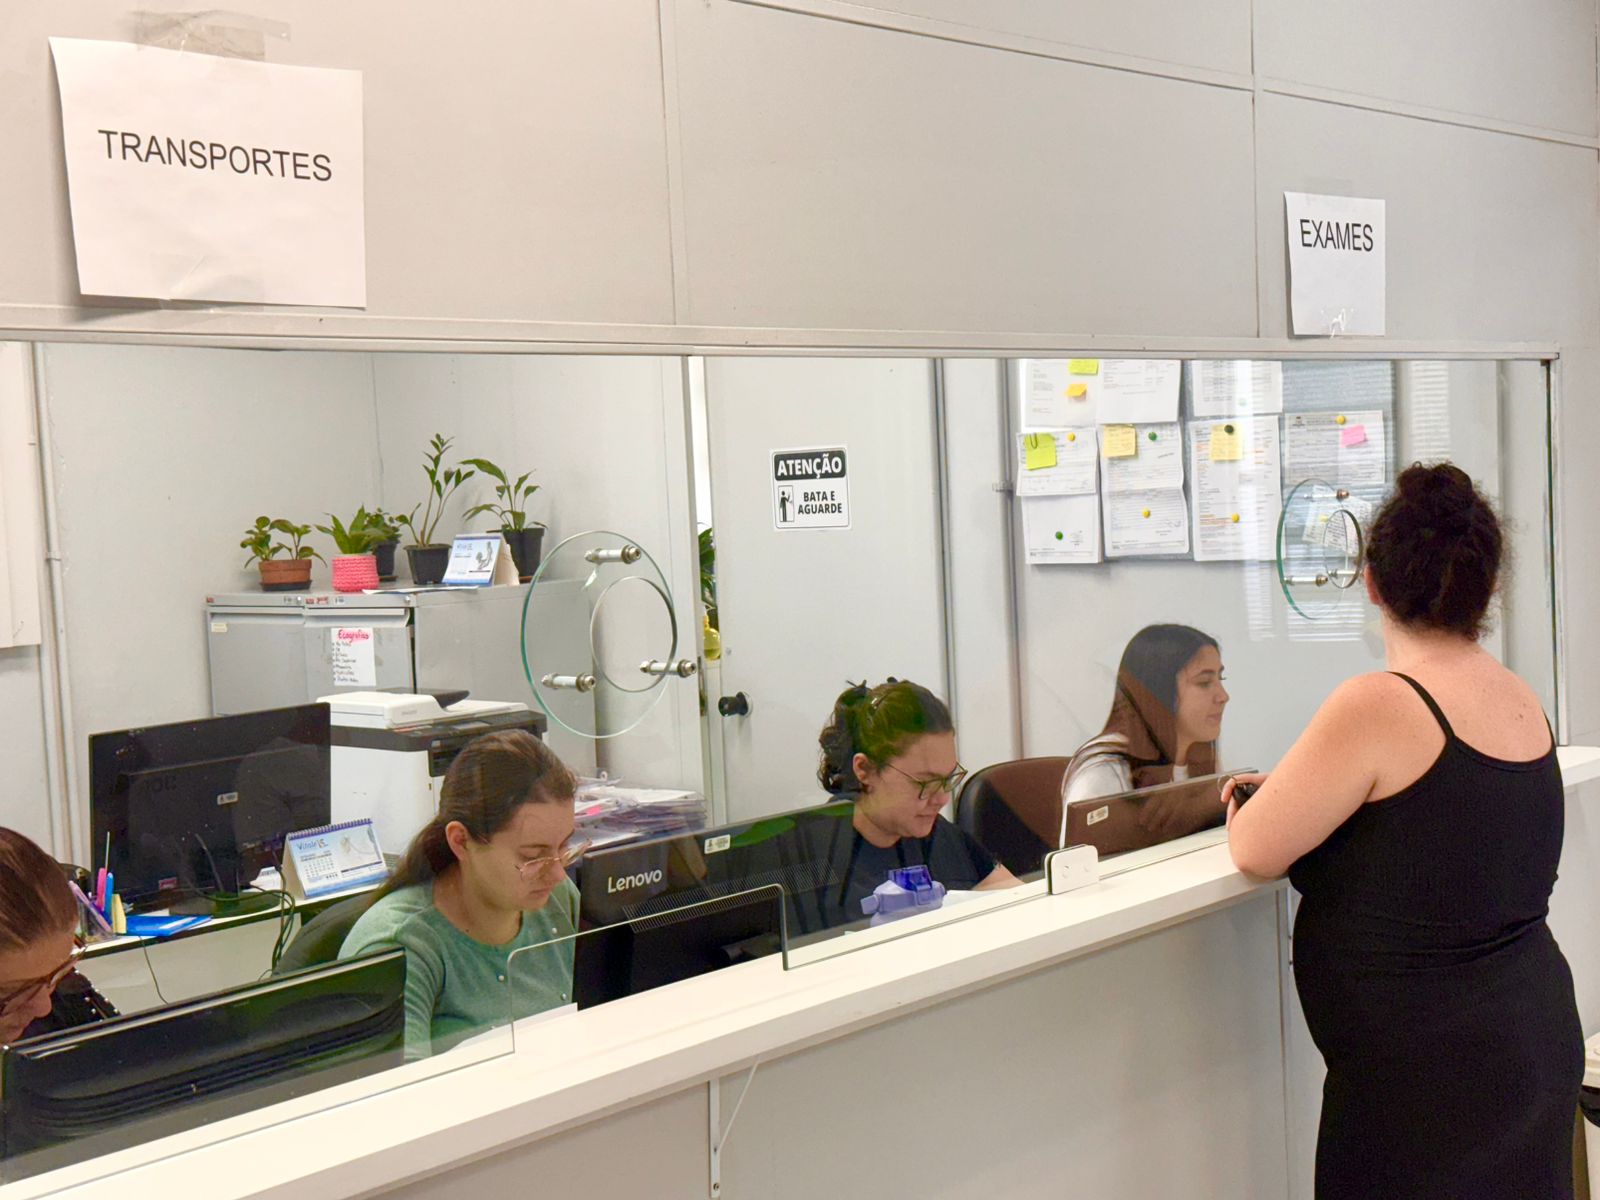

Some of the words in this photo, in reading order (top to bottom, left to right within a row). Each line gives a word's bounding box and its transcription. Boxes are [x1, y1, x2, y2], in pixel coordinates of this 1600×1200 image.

[98, 129, 332, 182] TRANSPORTES
[1299, 218, 1374, 252] EXAMES
[777, 453, 842, 479] ATENÇÃO
[798, 503, 842, 514] AGUARDE
[803, 491, 828, 502] BATA
[830, 490, 836, 501] E
[608, 869, 663, 894] Lenovo
